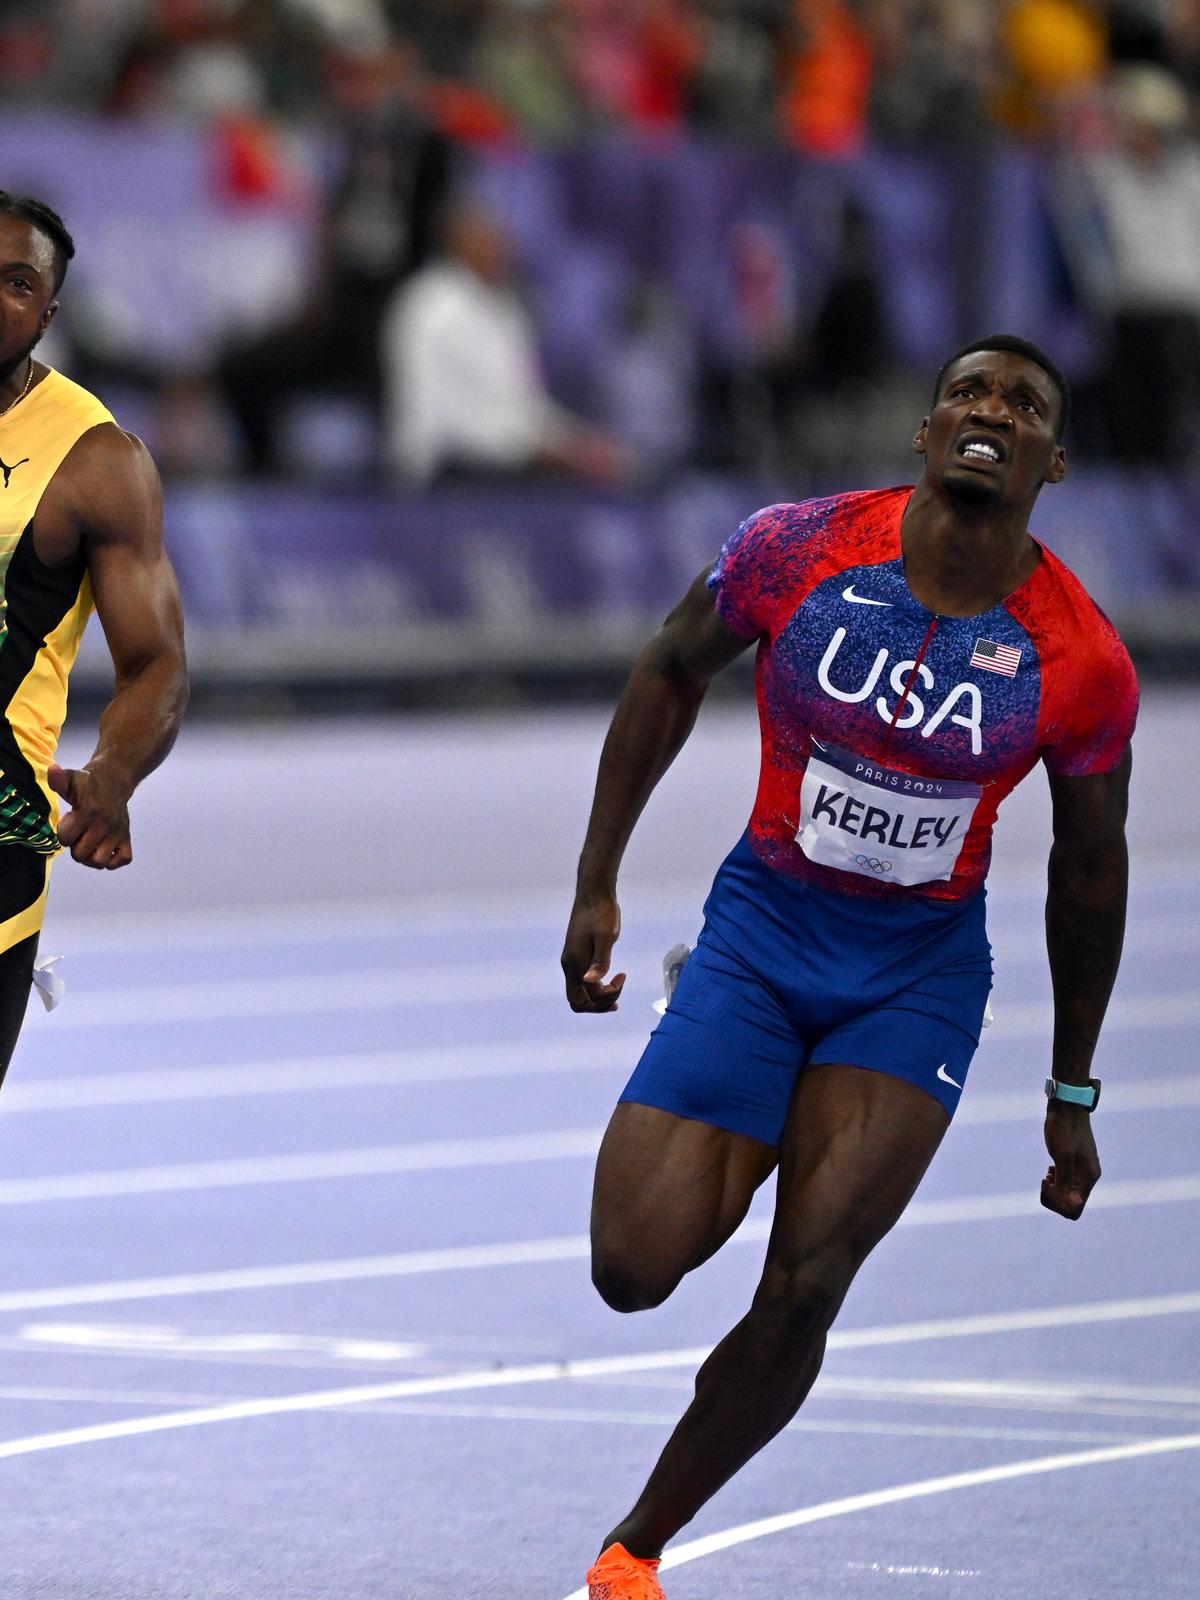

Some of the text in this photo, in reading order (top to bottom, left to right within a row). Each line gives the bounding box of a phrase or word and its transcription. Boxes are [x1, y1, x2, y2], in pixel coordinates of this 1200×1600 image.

[818, 627, 983, 756] USA
[855, 763, 943, 794] PARIS 2024
[811, 784, 961, 849] KERLEY
